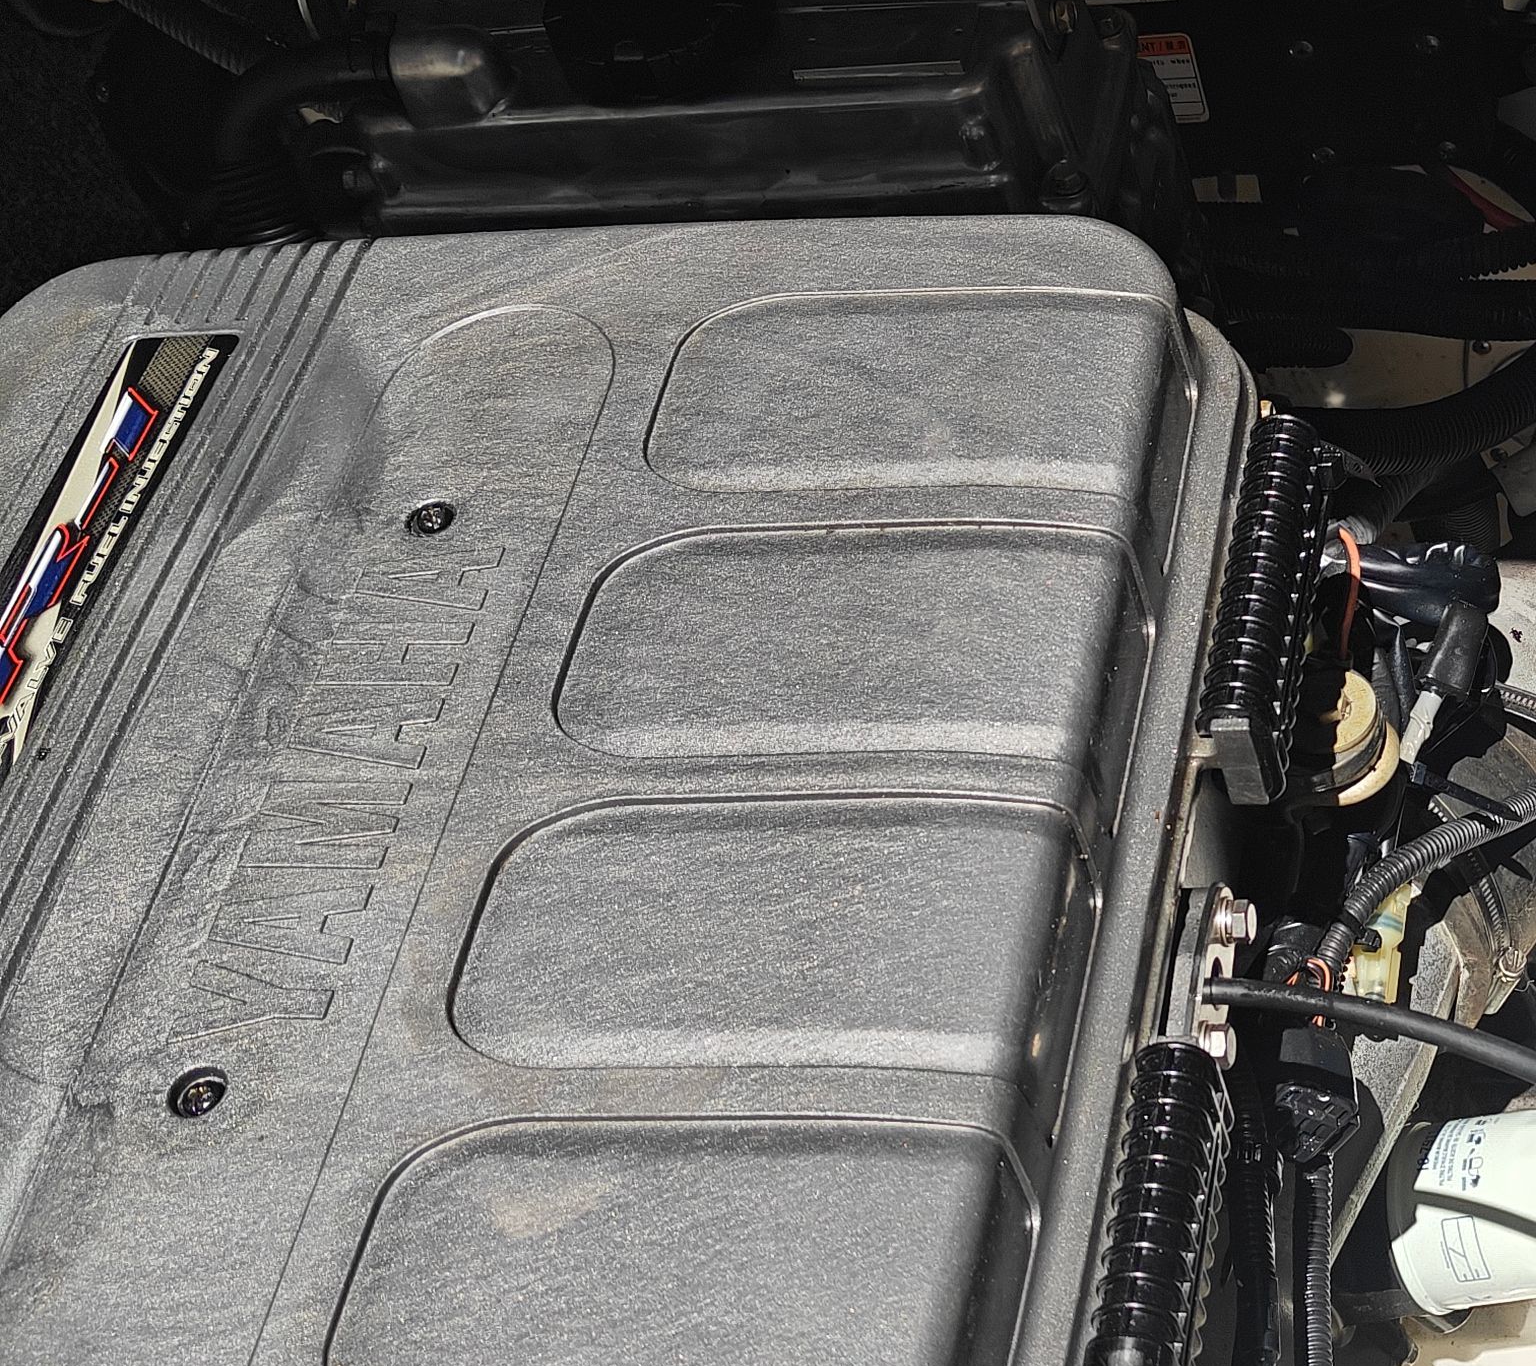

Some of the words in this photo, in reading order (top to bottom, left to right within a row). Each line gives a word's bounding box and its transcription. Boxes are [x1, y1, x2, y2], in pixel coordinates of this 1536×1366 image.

[0, 617, 73, 743] VALVE
[70, 515, 128, 605] FUEL
[123, 346, 218, 513] INJECTION
[168, 545, 503, 1044] YAMAHA
